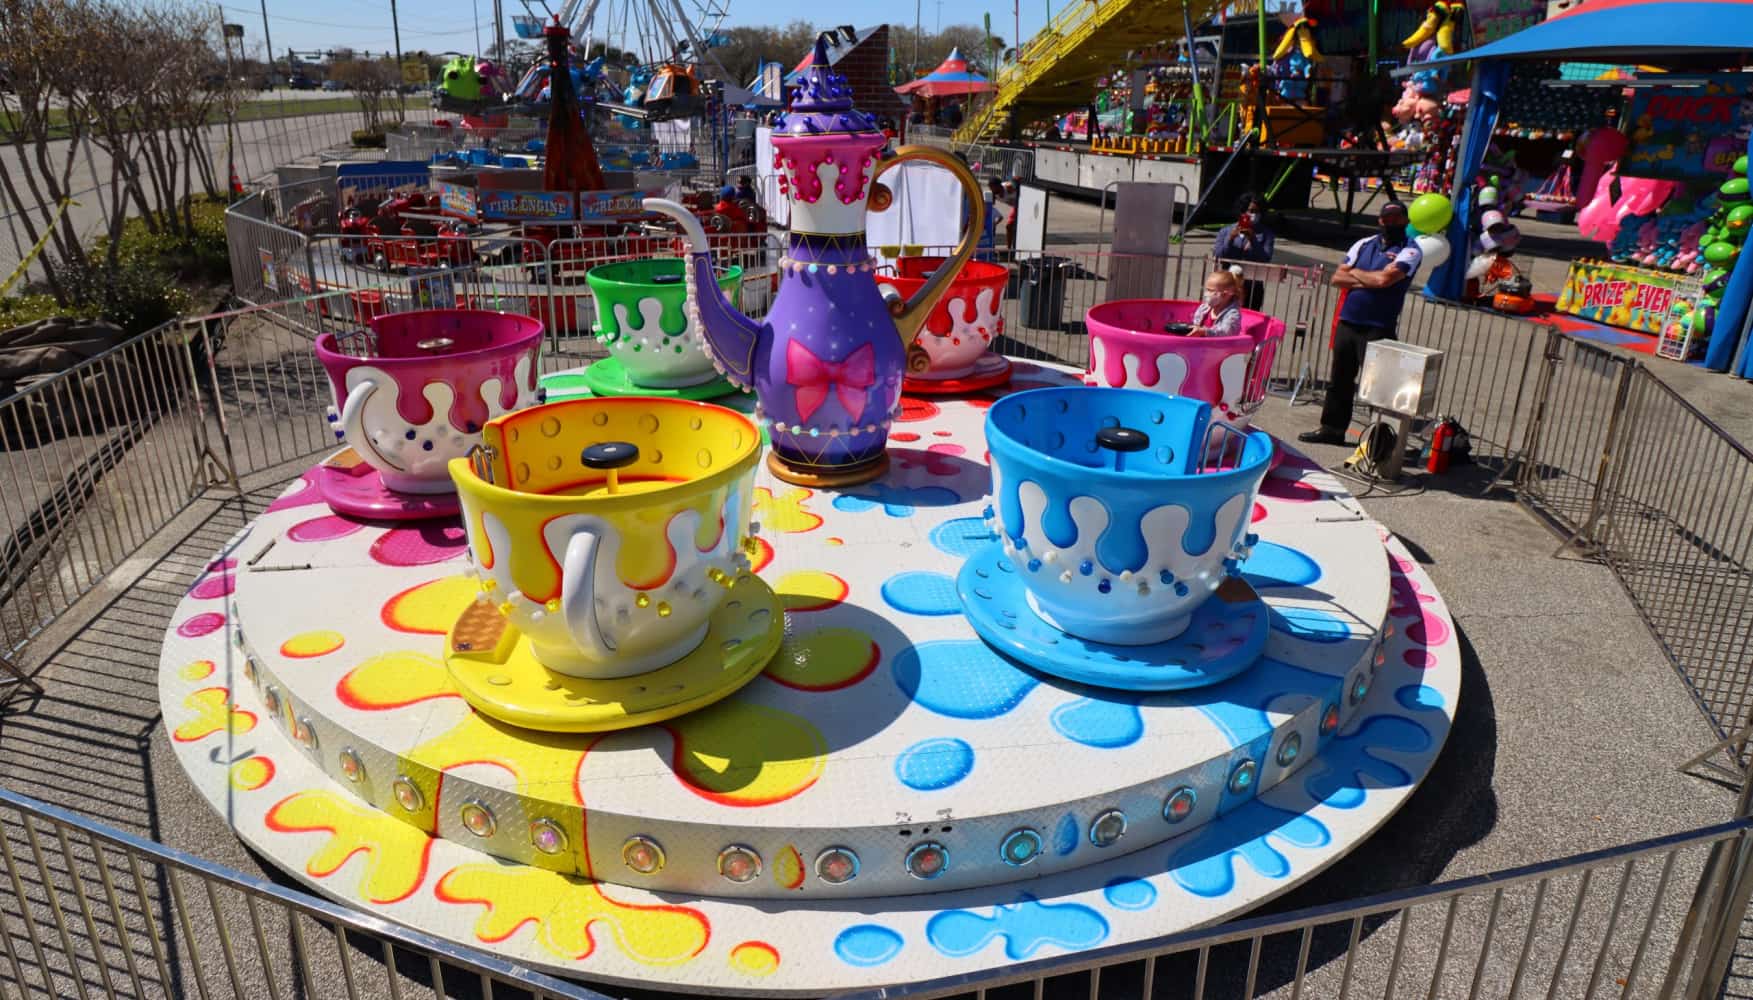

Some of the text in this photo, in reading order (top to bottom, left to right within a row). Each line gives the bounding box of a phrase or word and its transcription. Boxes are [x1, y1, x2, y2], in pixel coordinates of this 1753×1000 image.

[1646, 95, 1740, 123] DUCK
[489, 200, 566, 214] FIRE ENGINE
[1583, 280, 1627, 307] PRIZE
